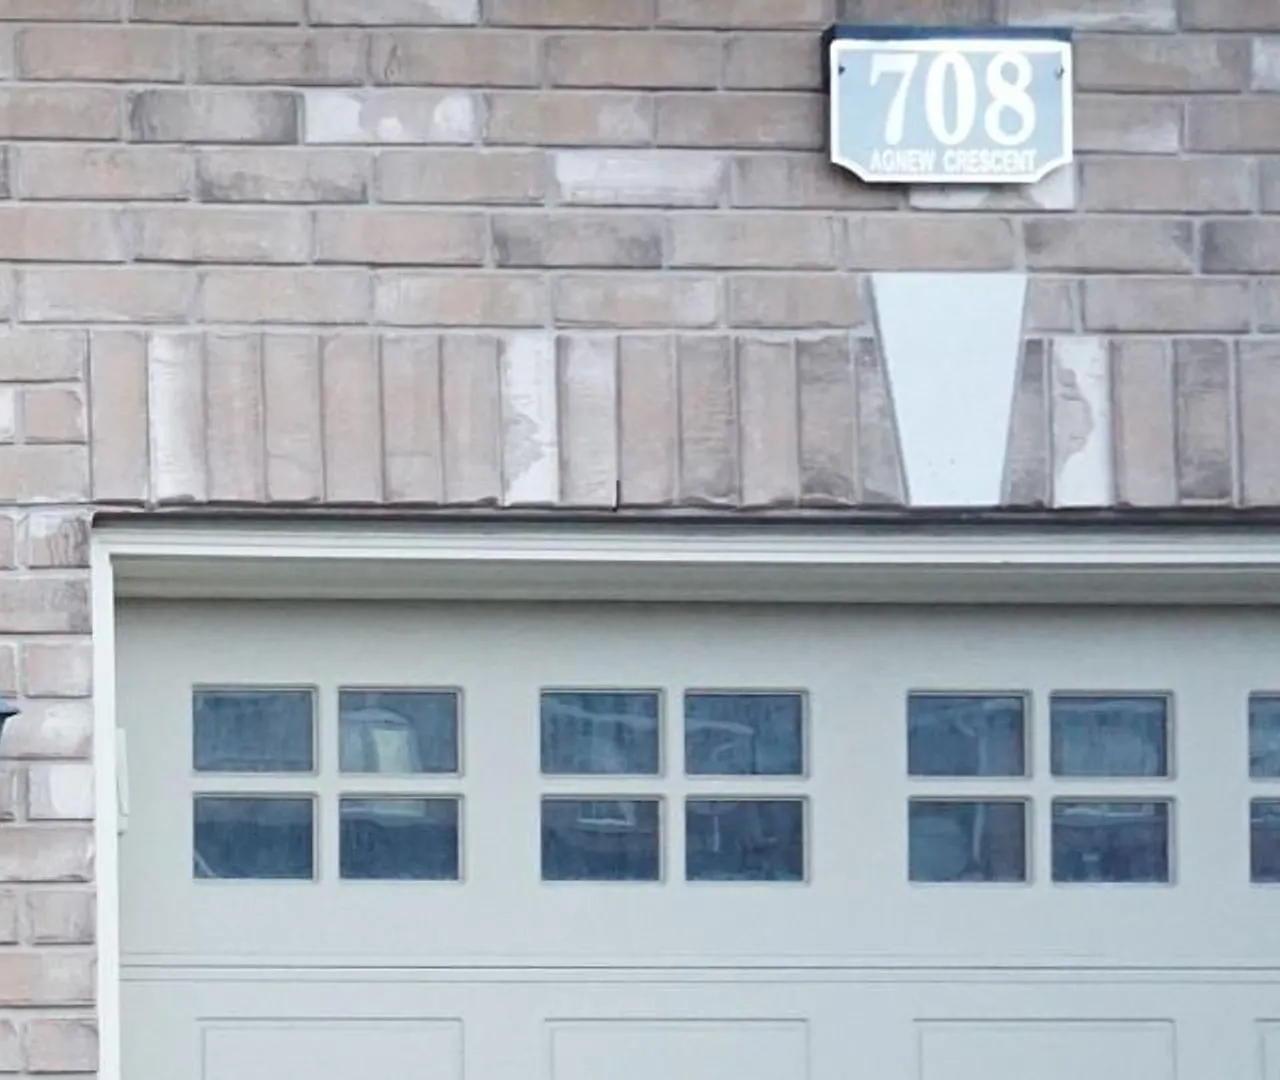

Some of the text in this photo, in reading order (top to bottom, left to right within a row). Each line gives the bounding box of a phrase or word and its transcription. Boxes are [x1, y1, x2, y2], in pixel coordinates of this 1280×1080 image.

[870, 51, 1036, 146] 708
[870, 148, 1038, 173] AGNEW CRESCENT
